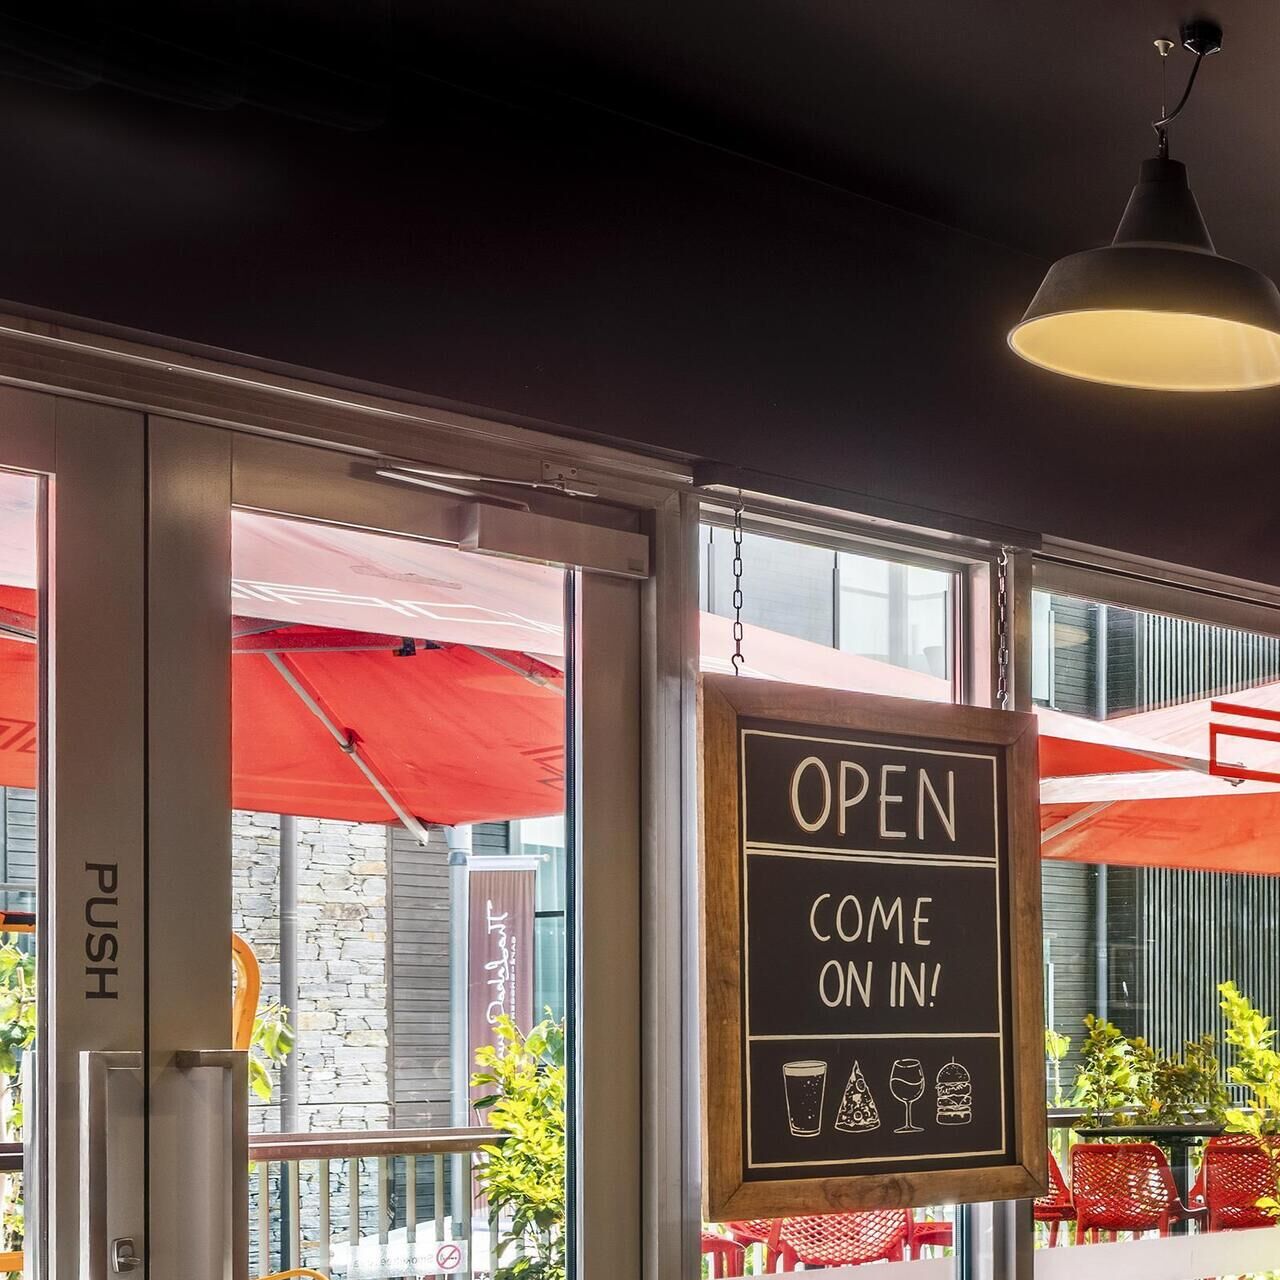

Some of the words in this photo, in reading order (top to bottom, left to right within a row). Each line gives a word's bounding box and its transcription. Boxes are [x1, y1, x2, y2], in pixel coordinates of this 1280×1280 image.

[790, 756, 956, 842] OPEN
[85, 861, 119, 1000] PUSH
[810, 893, 932, 946] COME
[819, 960, 873, 1008] ON
[890, 961, 941, 1008] IN!
